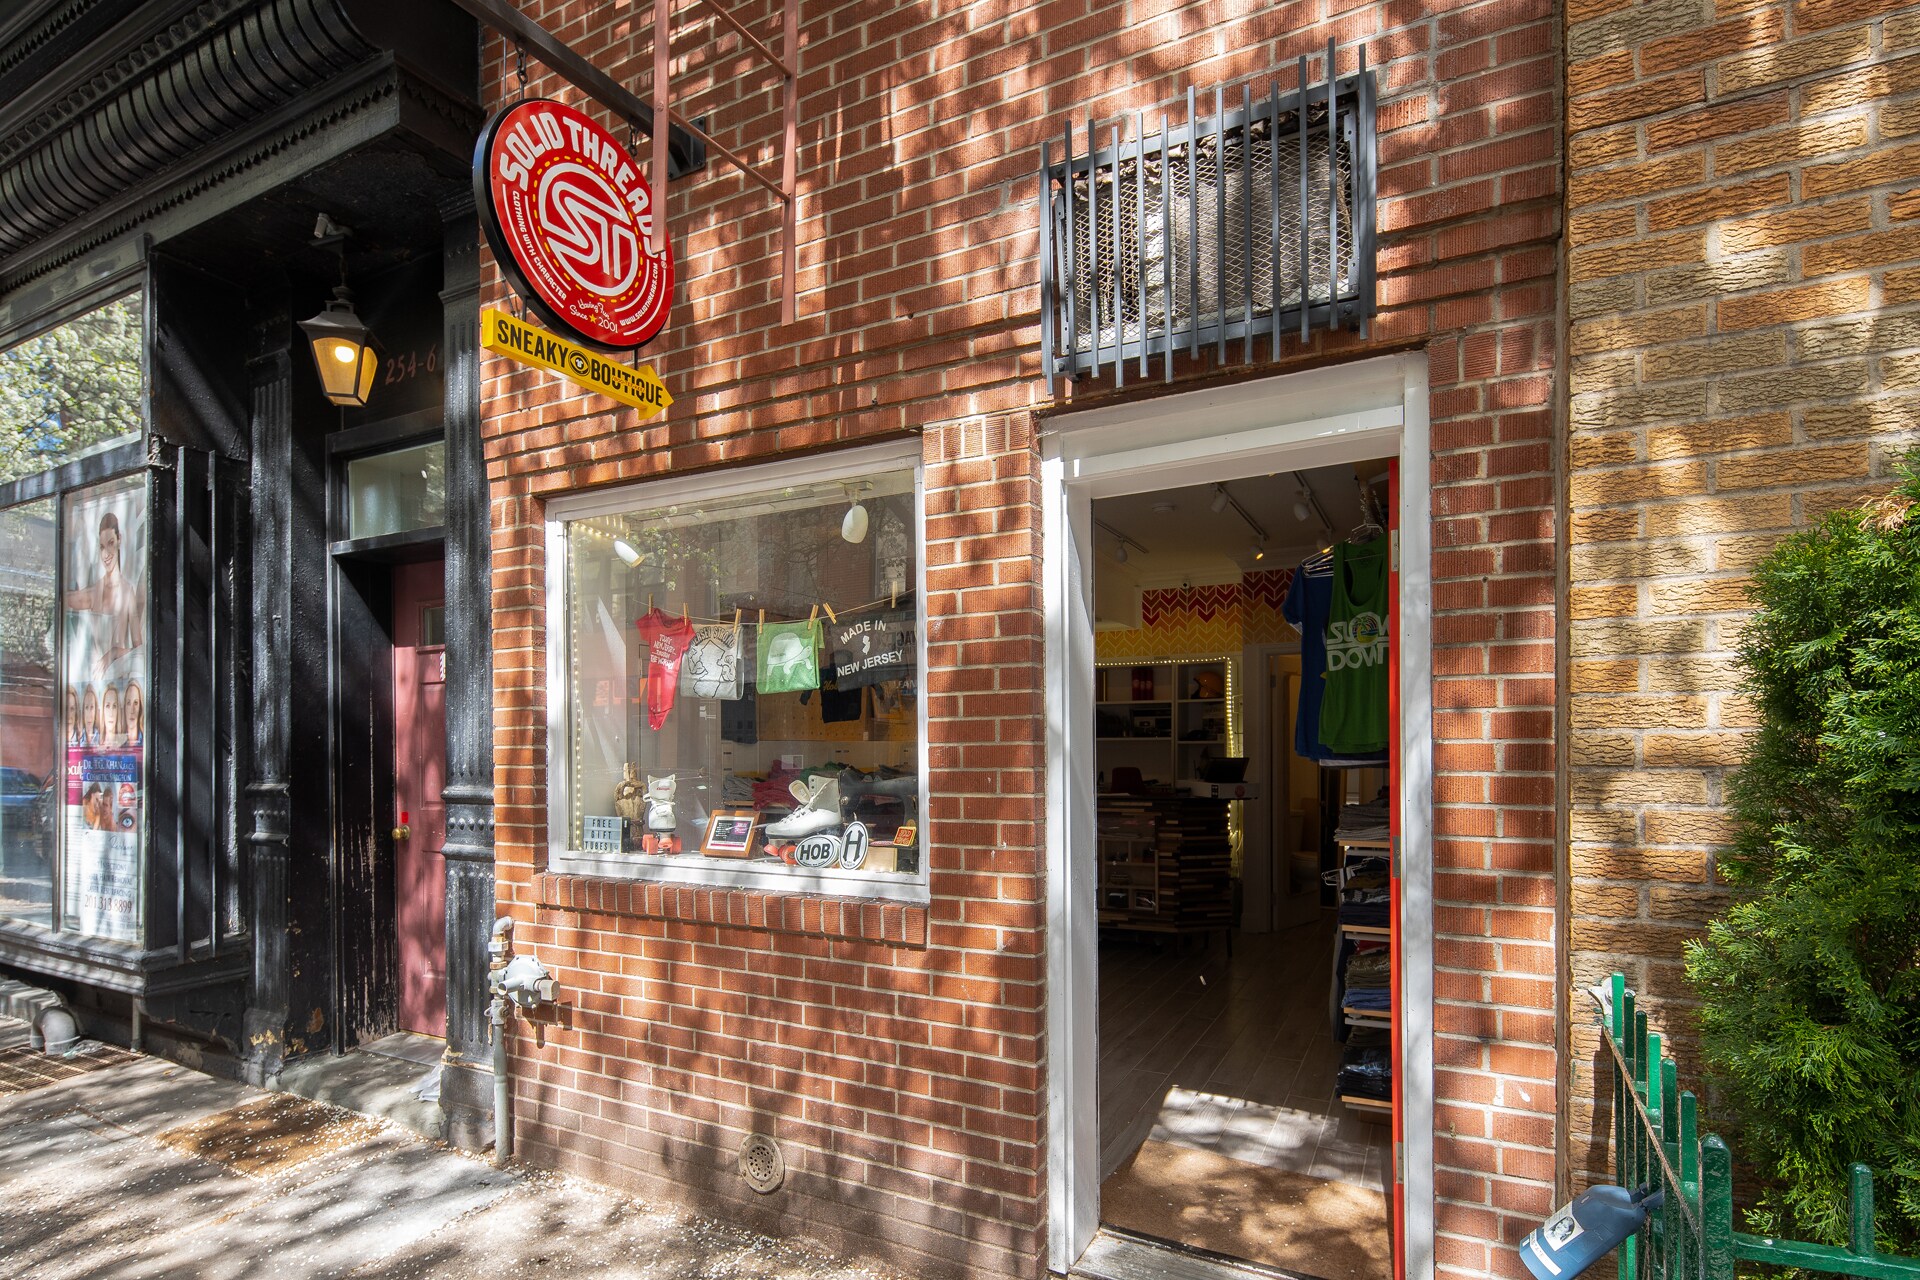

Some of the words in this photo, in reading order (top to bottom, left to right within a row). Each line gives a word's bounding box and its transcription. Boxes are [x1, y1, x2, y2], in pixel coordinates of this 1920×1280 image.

[500, 112, 565, 191] SOLID
[512, 190, 527, 233] CLOTHING
[522, 234, 536, 256] WITH
[533, 256, 567, 300] CHARACTER
[569, 304, 589, 321] Since
[598, 316, 619, 333] 2001
[577, 298, 599, 314] Having
[597, 302, 611, 320] Fun
[497, 319, 569, 368] SNEAKY
[590, 355, 663, 408] BOUTIQUE
[840, 620, 872, 645] MADE
[874, 619, 887, 632] IN
[837, 661, 860, 677] NEW
[861, 648, 904, 670] JERSEY
[590, 830, 612, 840] GIFT
[592, 818, 612, 828] FREE
[799, 843, 831, 861] HOB
[842, 829, 865, 862] H
